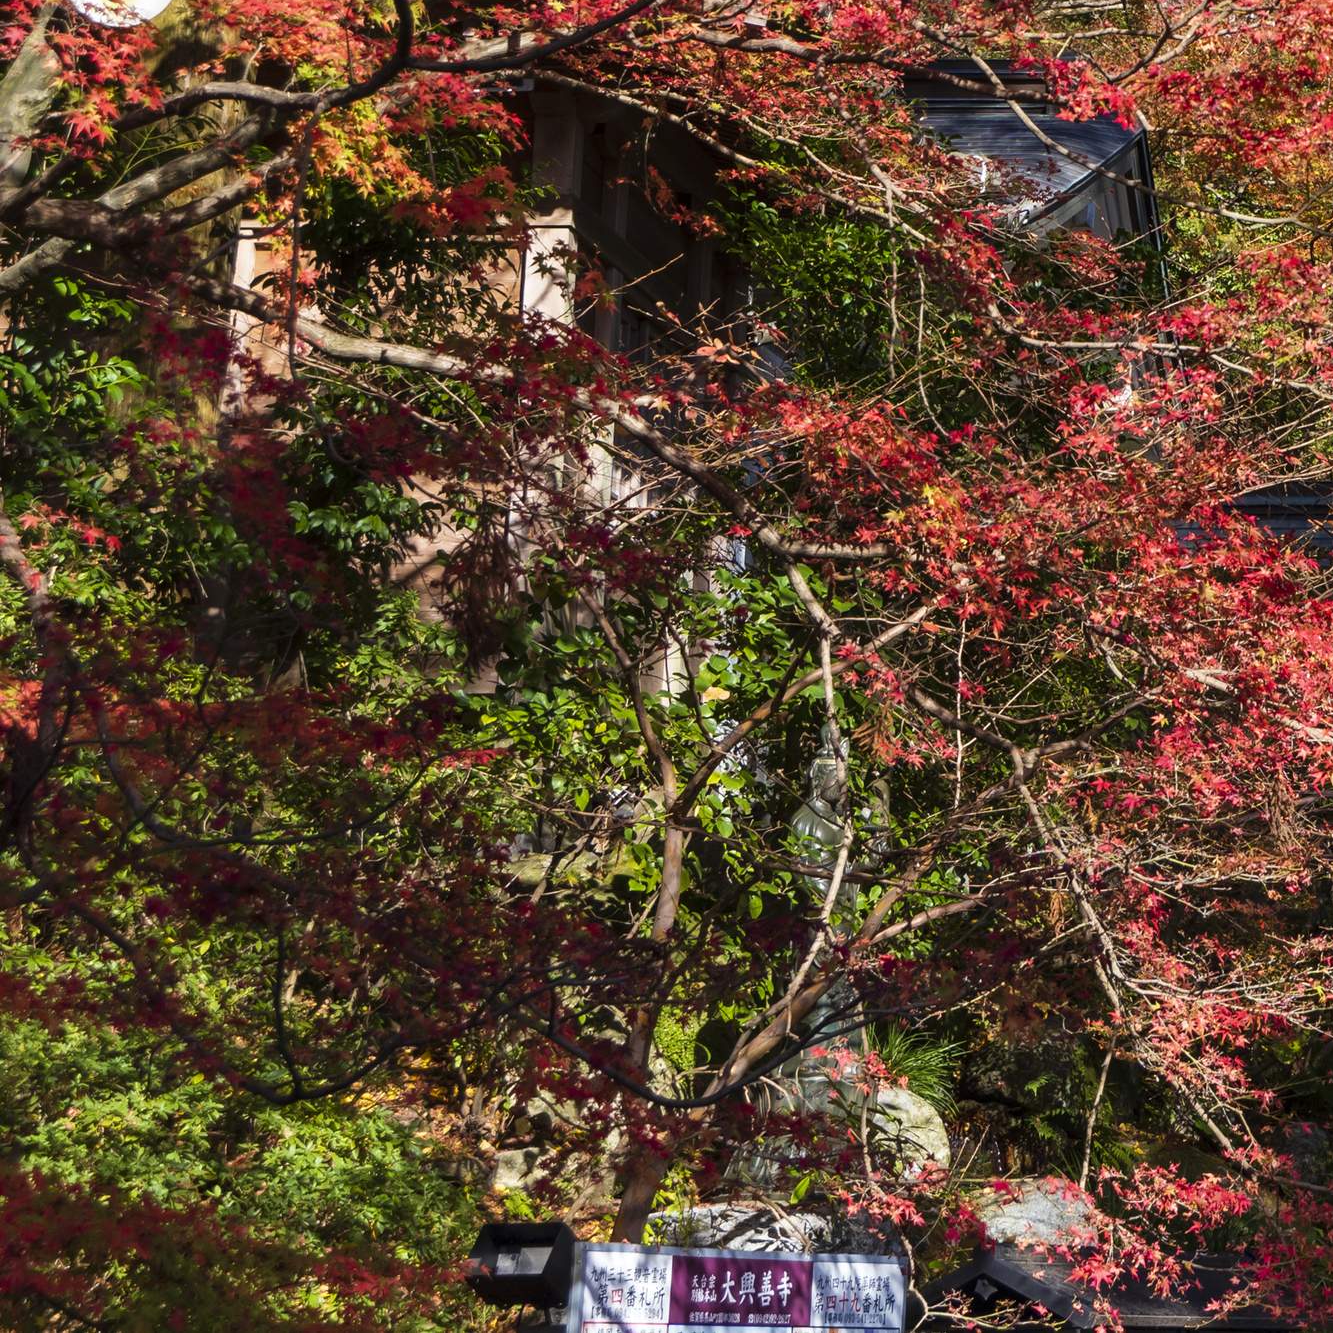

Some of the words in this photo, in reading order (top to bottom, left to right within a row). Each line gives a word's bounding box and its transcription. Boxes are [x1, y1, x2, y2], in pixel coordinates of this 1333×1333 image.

[590, 1265, 668, 1285] 九州三十三観音霊場
[691, 1274, 717, 1288] 天台宗
[597, 1283, 666, 1308] 第四番札所
[691, 1287, 717, 1303] 別格本山
[720, 1270, 793, 1307] 大興善寺
[814, 1291, 896, 1314] 第四十九番札所
